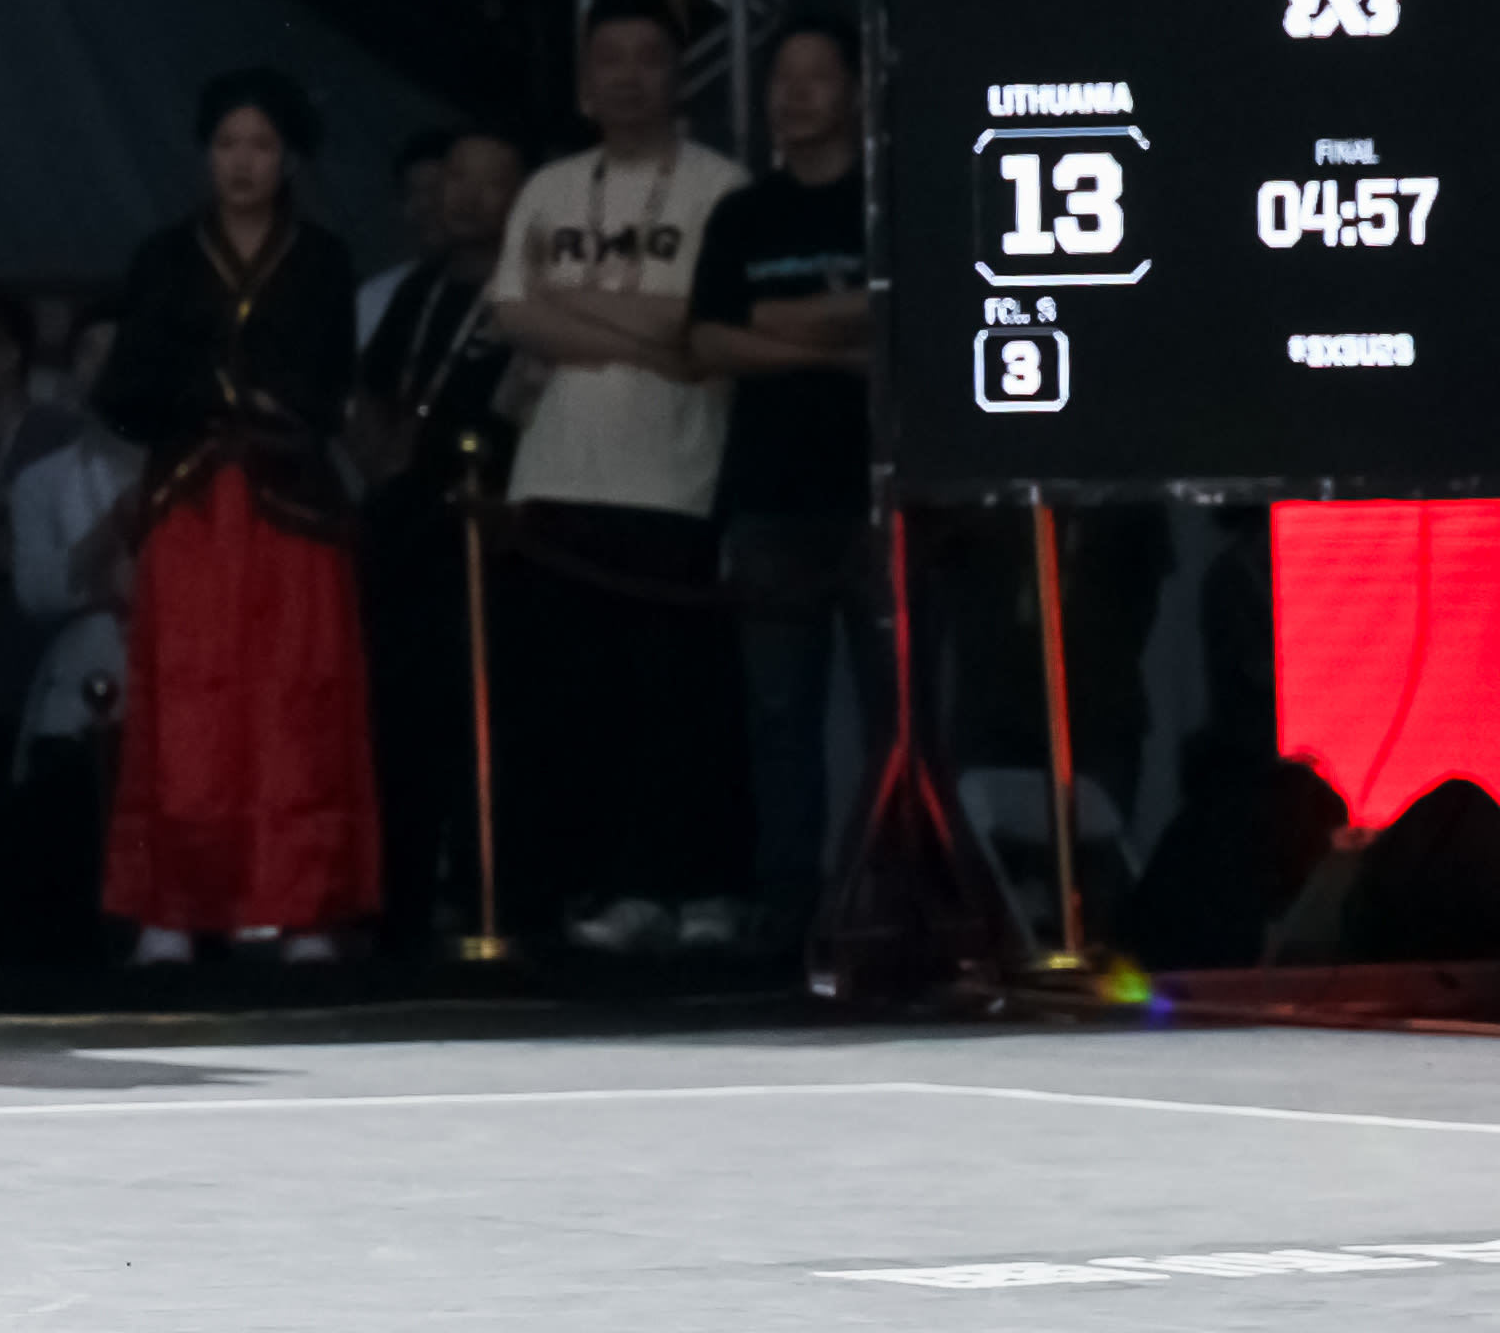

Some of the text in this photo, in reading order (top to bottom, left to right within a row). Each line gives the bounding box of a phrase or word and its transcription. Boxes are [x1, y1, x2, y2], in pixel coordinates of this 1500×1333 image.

[987, 82, 1134, 116] LITHUANIA
[1001, 152, 1124, 255] 13
[1257, 177, 1440, 249] 04:57
[1001, 340, 1042, 396] 3
